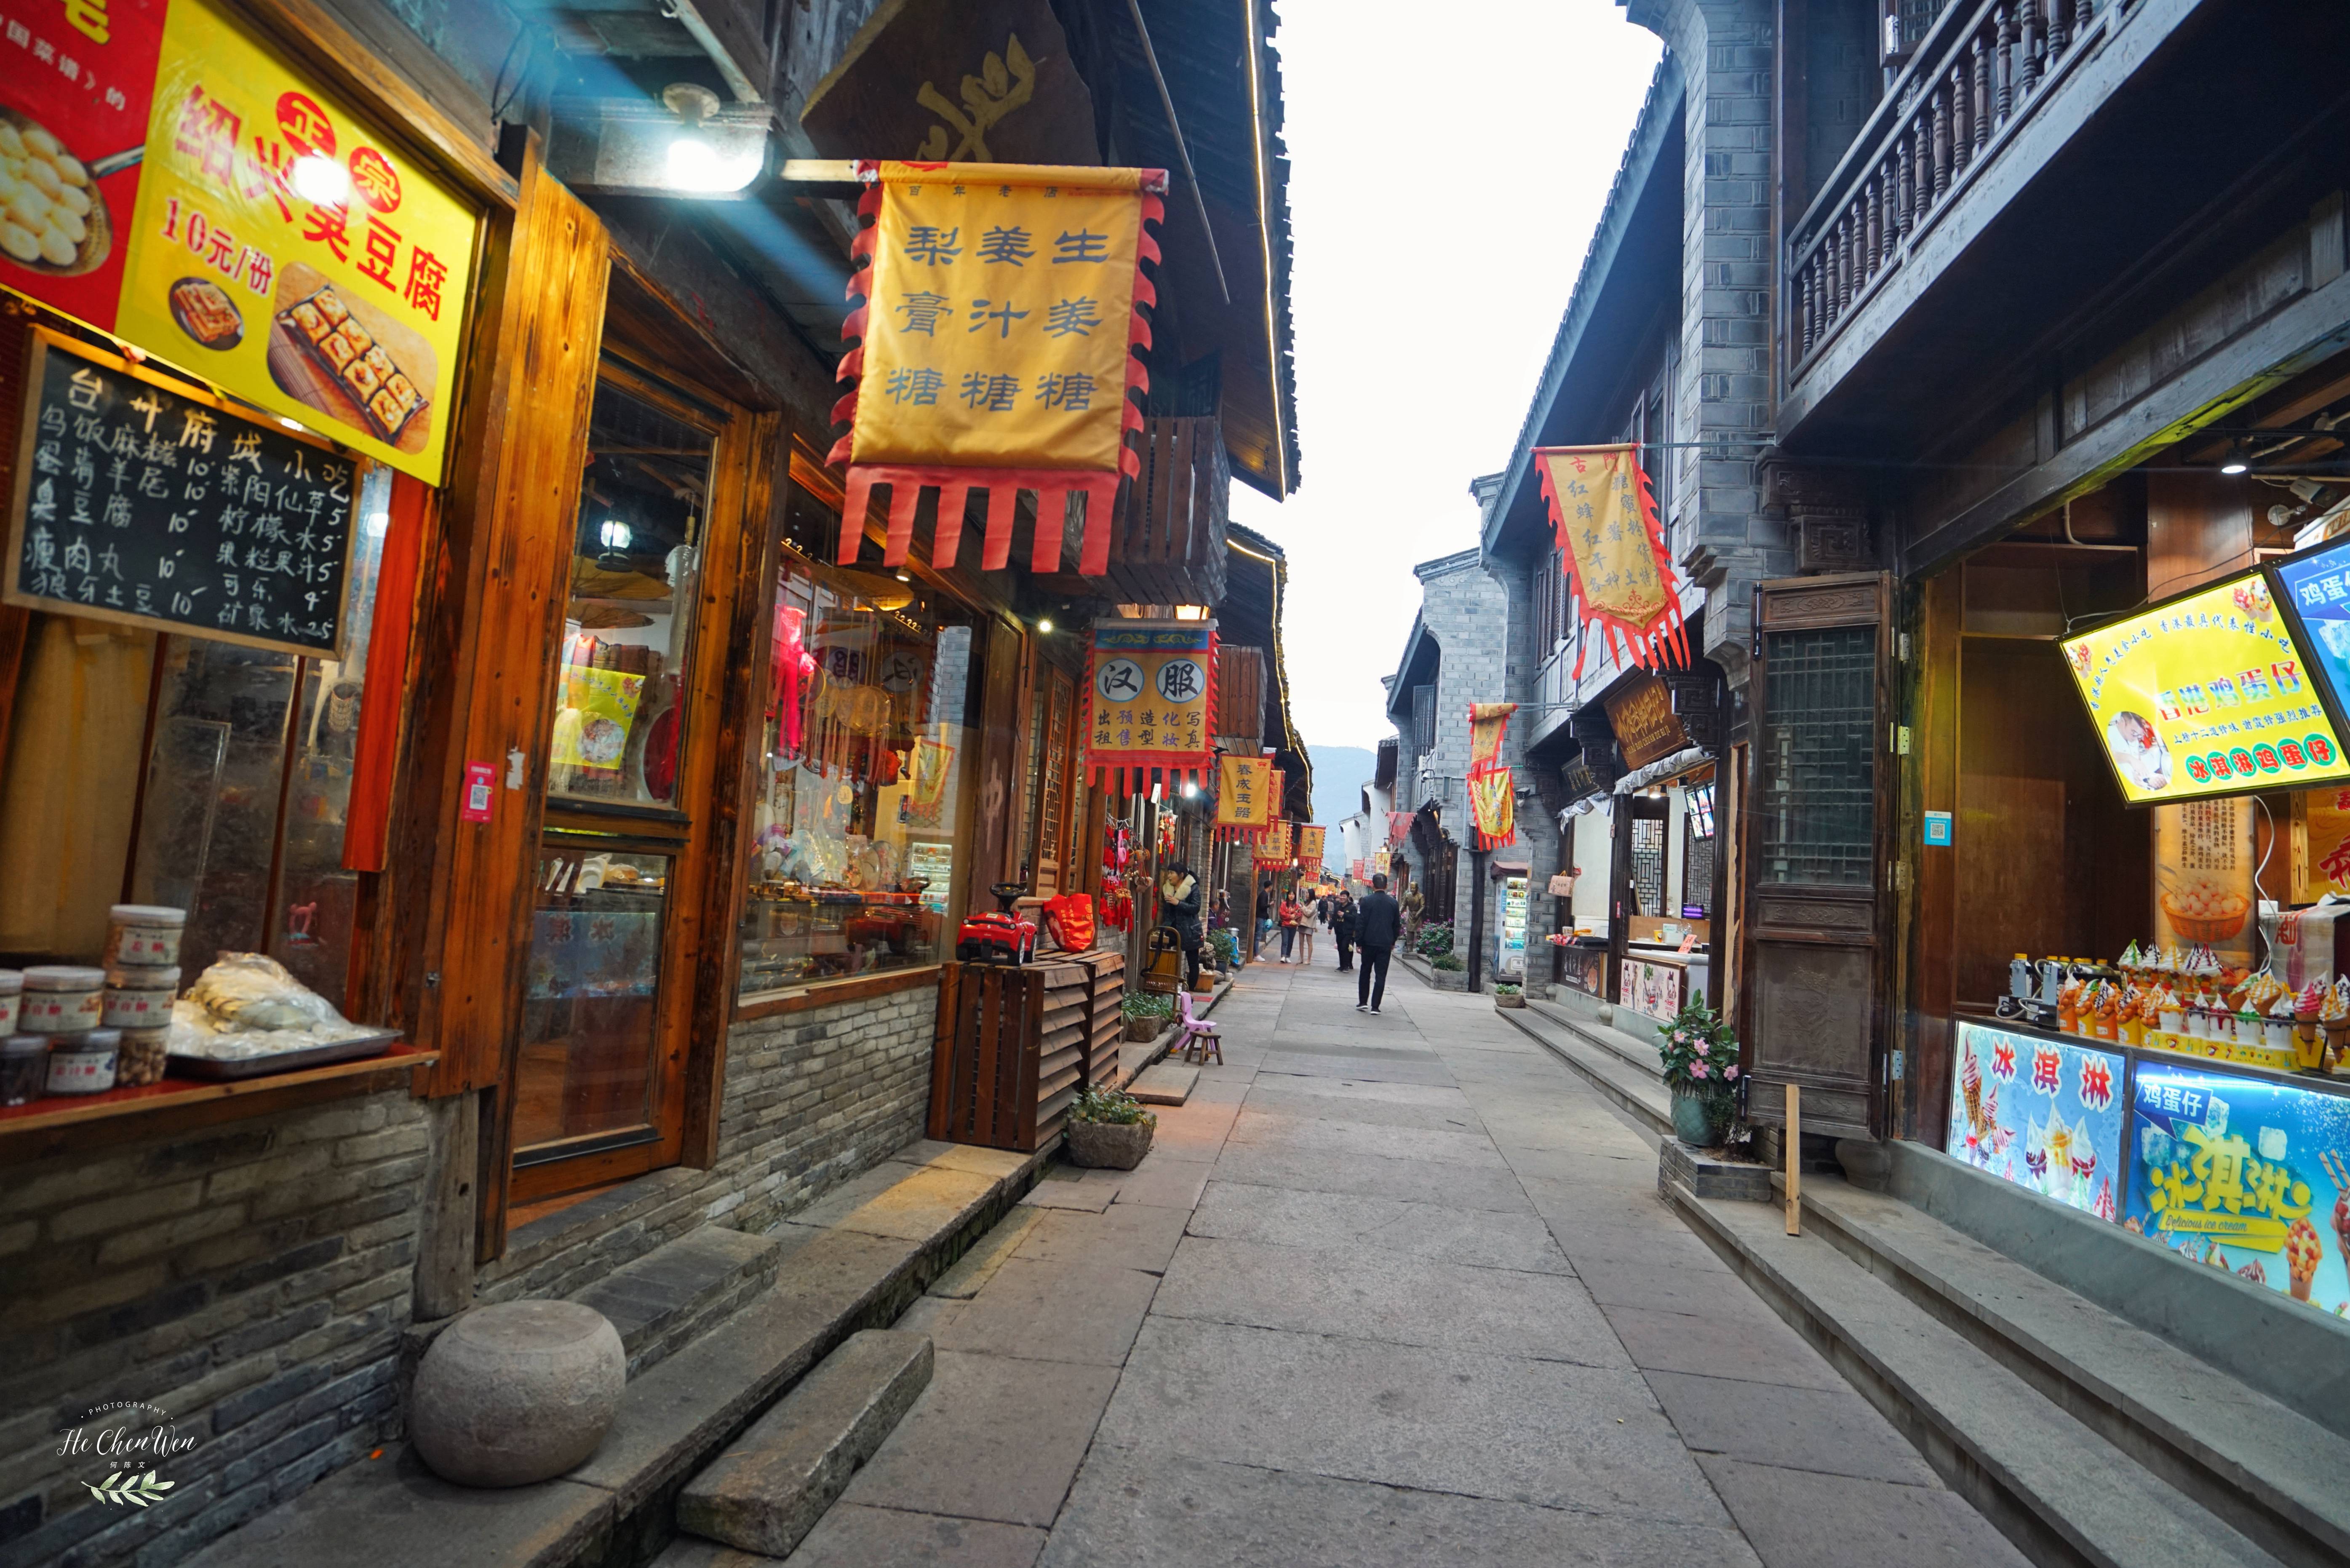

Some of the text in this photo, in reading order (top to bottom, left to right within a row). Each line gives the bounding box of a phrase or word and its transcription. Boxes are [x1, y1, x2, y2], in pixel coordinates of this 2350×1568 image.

[280, 96, 399, 211] 正宗
[909, 184, 1058, 198] 百年老店
[164, 197, 275, 296] 10元/份
[886, 226, 964, 406] 梨膏糖
[960, 226, 1036, 411] 姜汁糖
[1035, 228, 1110, 411] 生姜糖
[69, 368, 350, 504] 台州府城小吃
[30, 478, 133, 528] 臭豆腐
[221, 464, 326, 527] 紫阳仙草
[218, 503, 316, 551] 柠檬水
[24, 525, 124, 581] 瘦肉丸
[216, 540, 315, 584] 果粒果汁
[31, 571, 162, 618] 狼牙土豆
[222, 573, 272, 603] 可乐
[217, 601, 299, 636] 矿泉水
[2159, 613, 2291, 654] 香港最具代表性小吃
[1104, 663, 1198, 698] 汉服
[2158, 660, 2303, 721] 香港鸡蛋仔
[1094, 709, 1112, 746] 出租
[1116, 710, 1133, 746] 预售
[1138, 709, 1157, 745] 造型
[1162, 711, 1180, 747] 化妆
[1185, 712, 1200, 748] 写真
[2189, 739, 2331, 779] 冰淇淋鸡蛋仔
[1235, 764, 1253, 819] 春成玉器
[1992, 1039, 2111, 1109] 冰淇淋
[2144, 1083, 2203, 1117] 鸡蛋仔
[2150, 1125, 2313, 1220] 冰淇淋
[2166, 1215, 2248, 1231] Delicious ice cream
